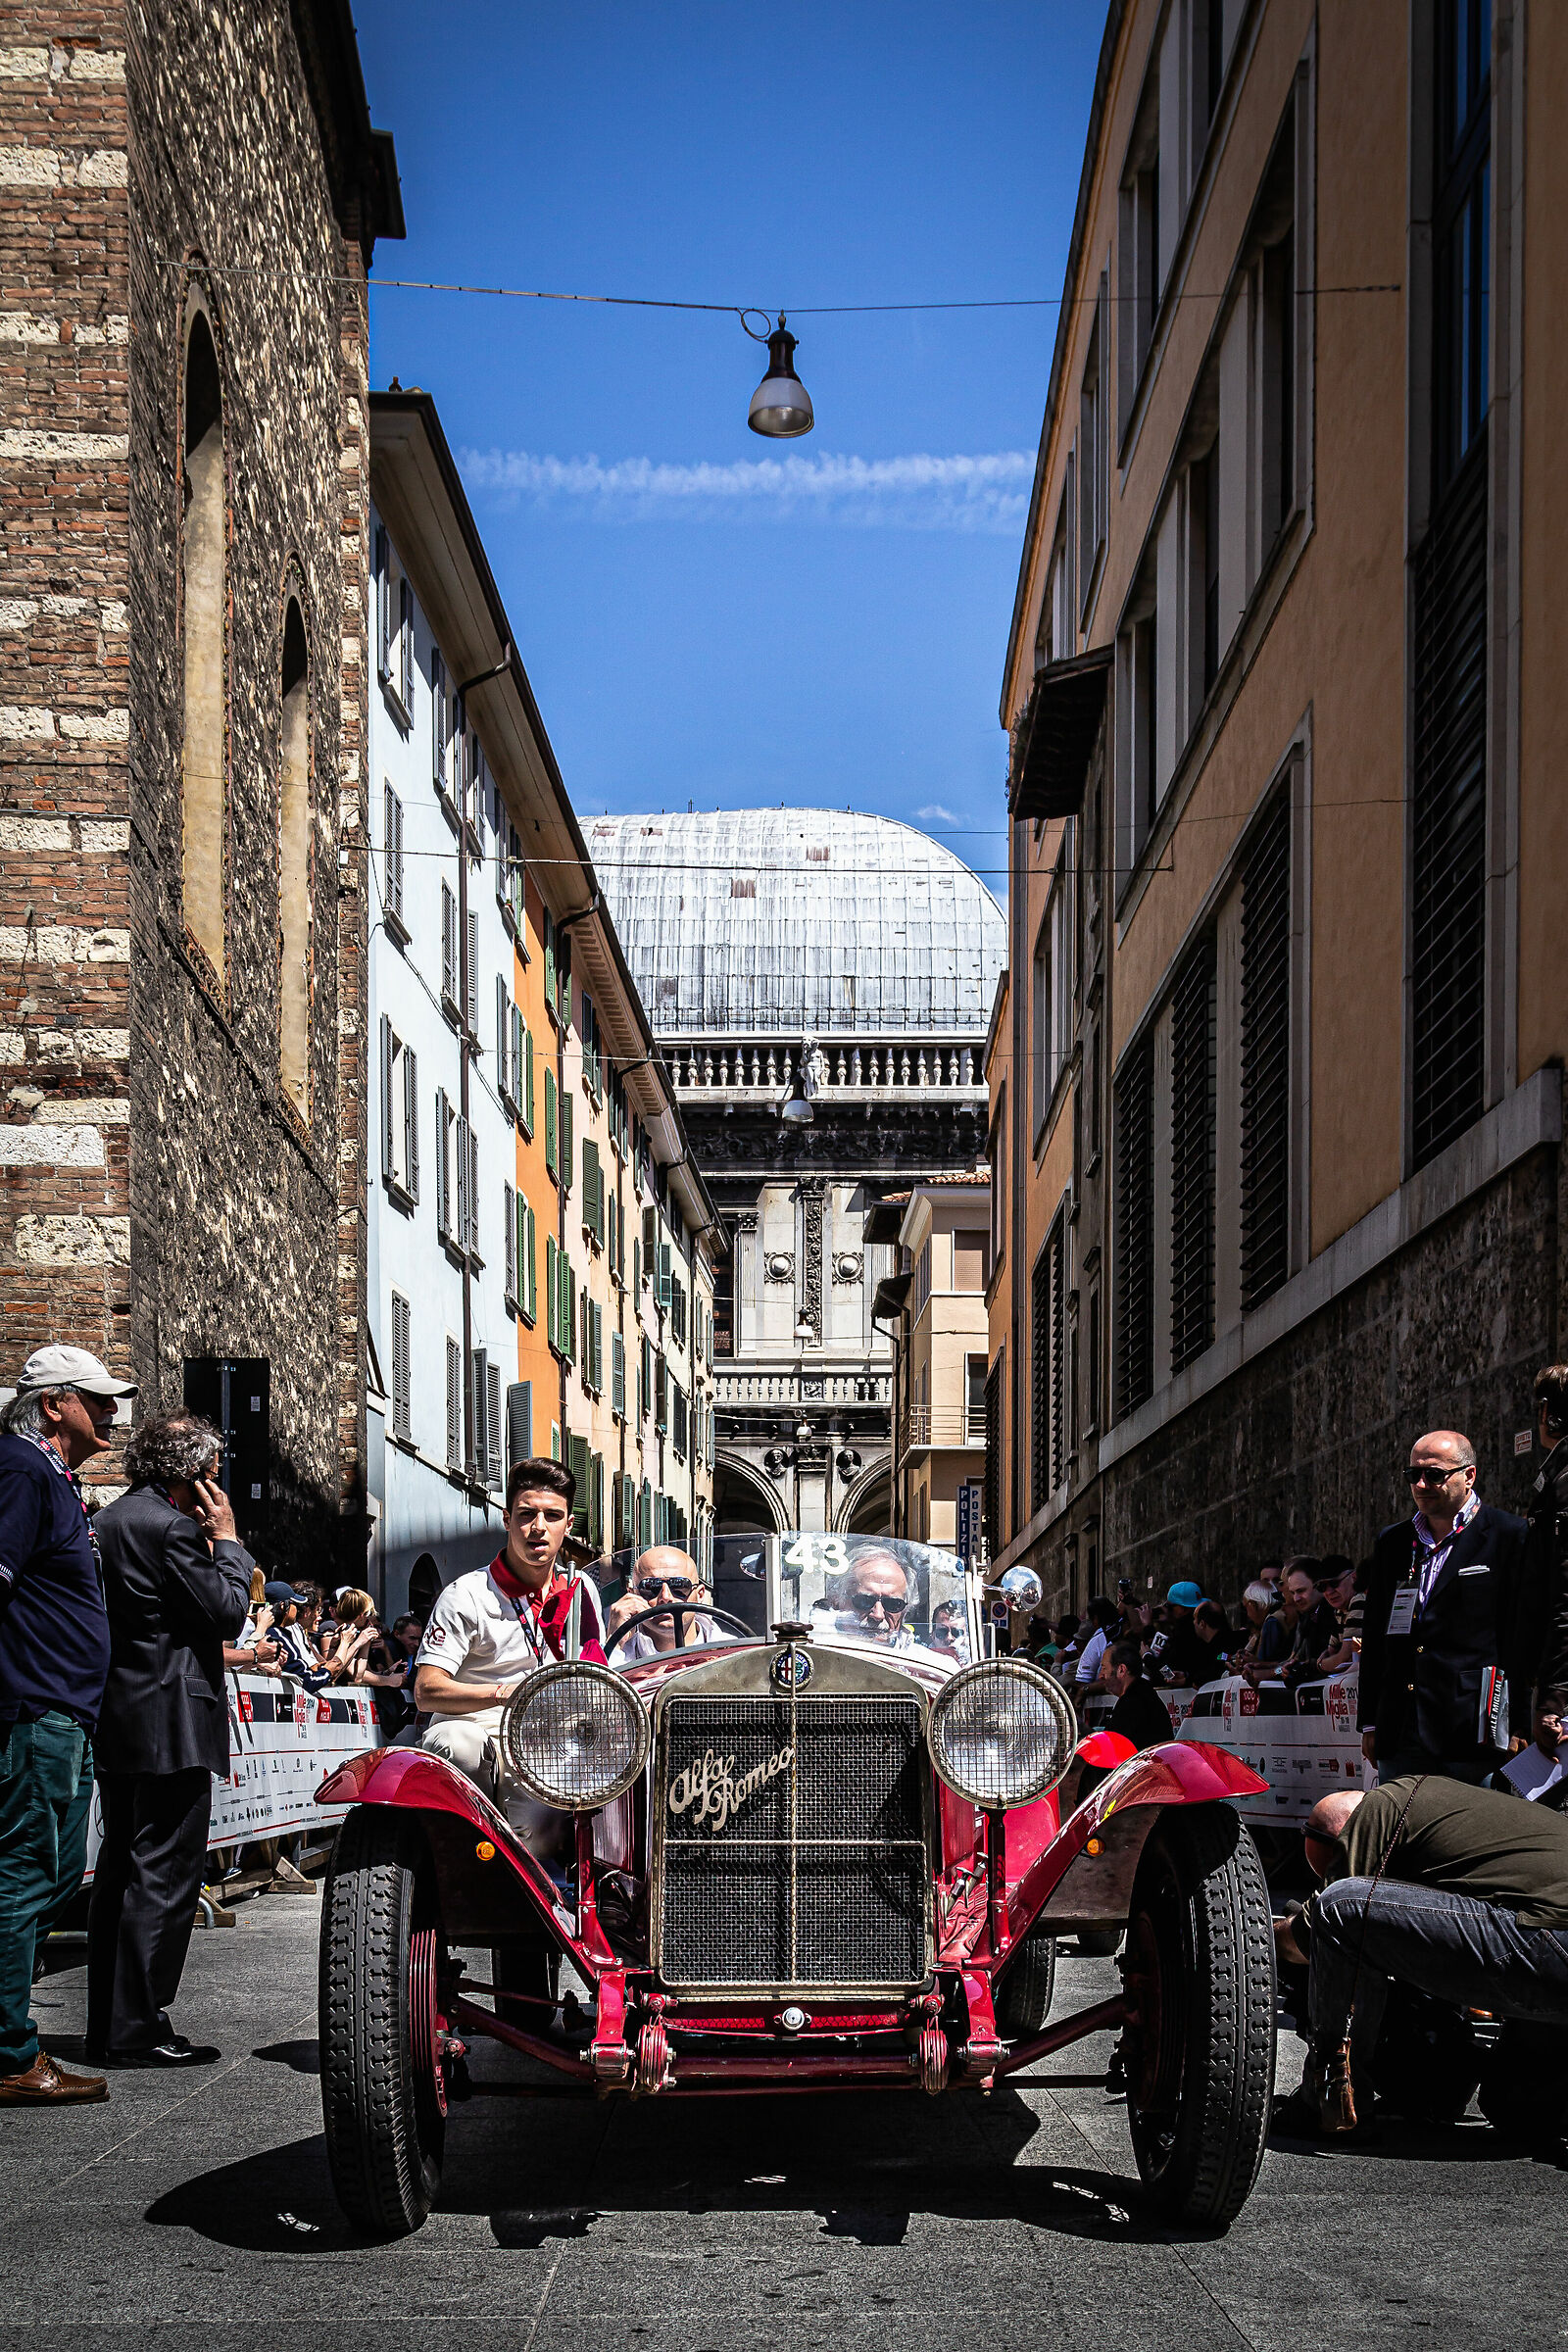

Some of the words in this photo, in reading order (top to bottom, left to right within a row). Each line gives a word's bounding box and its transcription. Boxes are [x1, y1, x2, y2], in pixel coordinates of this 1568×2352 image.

[785, 1533, 850, 1576] 43
[1329, 1679, 1347, 1699] Mille
[1347, 1687, 1358, 1699] 201
[1325, 1700, 1348, 1723] Miglia
[669, 1748, 734, 1825] Alfa
[707, 1746, 795, 1832] Romeo
